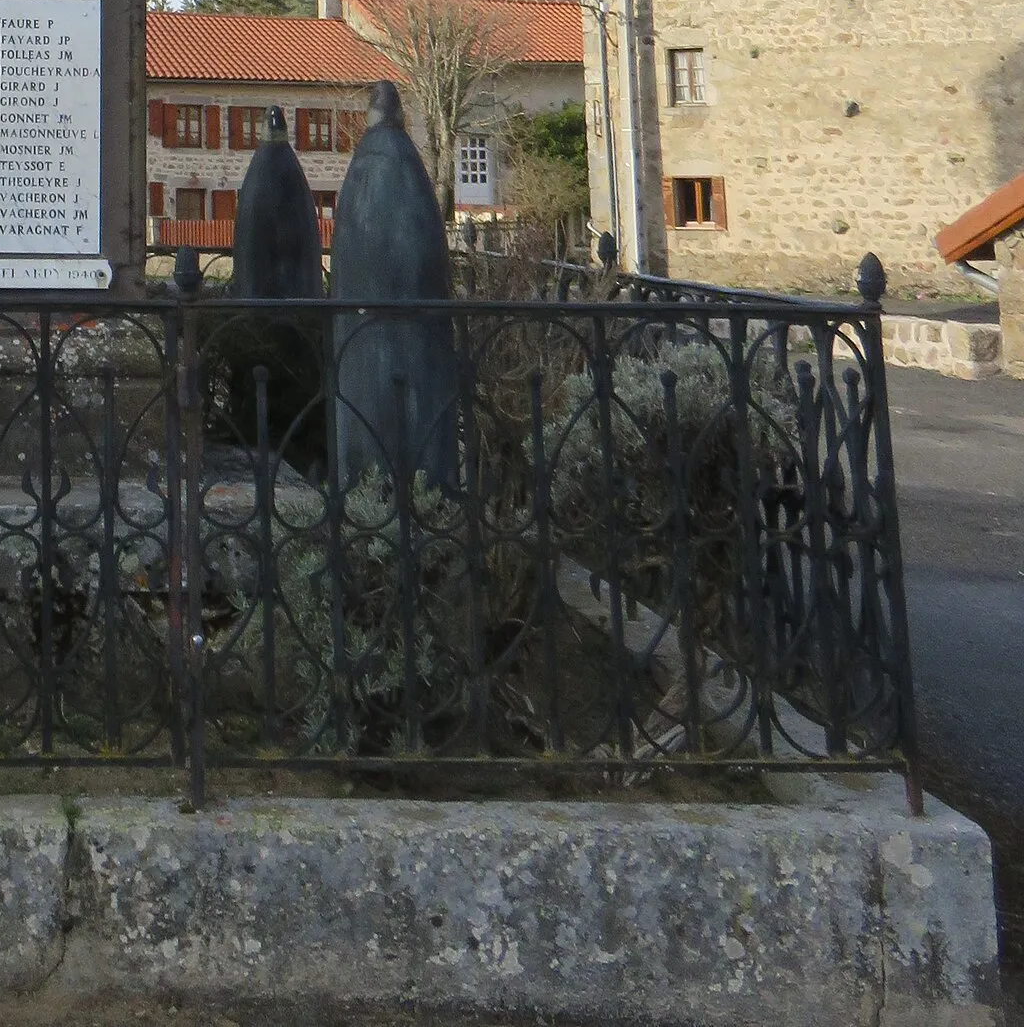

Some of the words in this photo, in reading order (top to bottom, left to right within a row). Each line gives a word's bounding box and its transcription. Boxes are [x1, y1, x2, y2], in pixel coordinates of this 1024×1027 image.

[1, 19, 40, 28] FAURE
[48, 20, 54, 28] P
[1, 36, 50, 44] FAYARD
[58, 36, 70, 45] JP
[1, 50, 50, 60] FOLLEAS
[58, 52, 73, 60] JM
[1, 67, 88, 76] FOUCHEYRAND
[93, 68, 100, 76] A
[0, 82, 45, 91] GIRARD
[54, 83, 59, 92] J
[0, 97, 45, 106] GIROND
[53, 98, 58, 107] J
[0, 114, 49, 123] GONNET
[58, 115, 72, 123] JM
[0, 129, 86, 139] MAISONNEUVE
[1, 146, 51, 155] MOSNIER
[59, 146, 74, 155] JM
[0, 162, 52, 171] TEYSSOT
[60, 162, 65, 171] E
[0, 177, 68, 187] THEOLEYRE
[76, 178, 81, 187] J
[0, 194, 66, 203] VACHERON
[74, 195, 78, 203] J
[0, 210, 66, 219] VACHERON
[73, 211, 88, 219] JM
[0, 225, 69, 235] VARAGNAT
[77, 227, 82, 235] F
